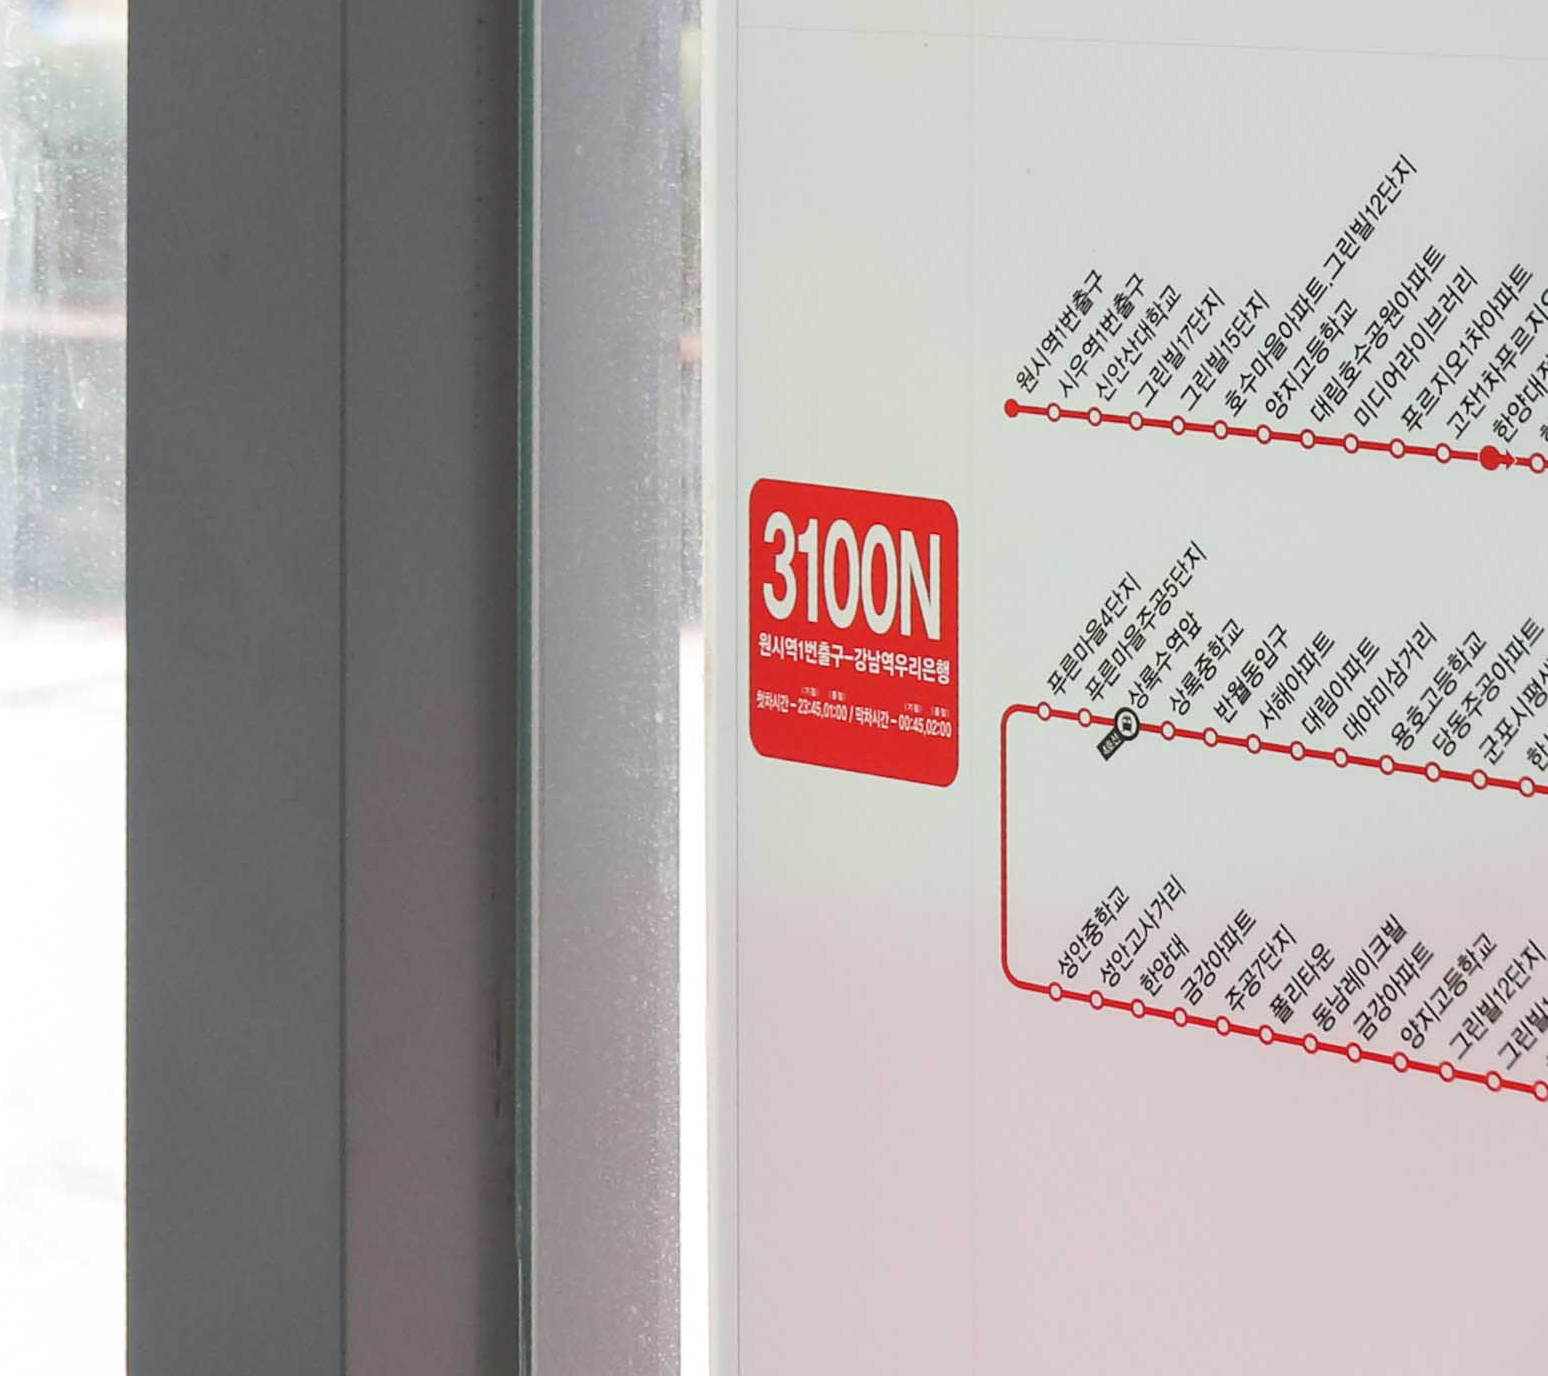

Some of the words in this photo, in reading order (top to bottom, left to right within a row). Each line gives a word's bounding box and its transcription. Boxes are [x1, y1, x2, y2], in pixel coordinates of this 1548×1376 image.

[1015, 269, 1103, 394] 원시역1번출구
[1058, 272, 1147, 399] 시우역1번출구
[1094, 283, 1182, 403] 신안산대학교
[1137, 286, 1226, 409] 그린빌17단지
[1180, 289, 1270, 413] 그린빌15단지
[1265, 298, 1358, 421] 양지고등학교
[1309, 244, 1446, 423] 대림호수공원아파트
[1354, 264, 1478, 427] 미디어라이브러리
[1400, 263, 1534, 433] 푸르지오1차아파트
[763, 510, 941, 640] 3100N
[1047, 571, 1141, 696] 푸른마을4단지
[1084, 540, 1207, 703] 푸른마을주공5단지
[1128, 610, 1203, 711] 상록수역앞
[1168, 618, 1245, 717] 상록중학교
[1213, 624, 1290, 725] 반월동입구
[1257, 629, 1335, 729] 서해아파트
[1302, 636, 1380, 736] 대림아파트
[1343, 620, 1437, 742] 대야미삼거리
[1390, 630, 1486, 751] 용호고등학교
[1432, 617, 1546, 757] 당동주공아파트
[1057, 885, 1129, 981] 성안중학교
[1098, 873, 1187, 989] 성안고사거리
[1139, 933, 1190, 997] 한양대
[1180, 908, 1256, 1006] 금강아파트
[1223, 923, 1298, 1014] 주공7단지
[1267, 942, 1338, 1025] 폴리타운
[1311, 913, 1408, 1033] 동남레이크빌
[1353, 941, 1434, 1041] 금강아파트
[1399, 932, 1497, 1050] 양지고등학교
[1449, 939, 1547, 1060] 그린빌12단지
